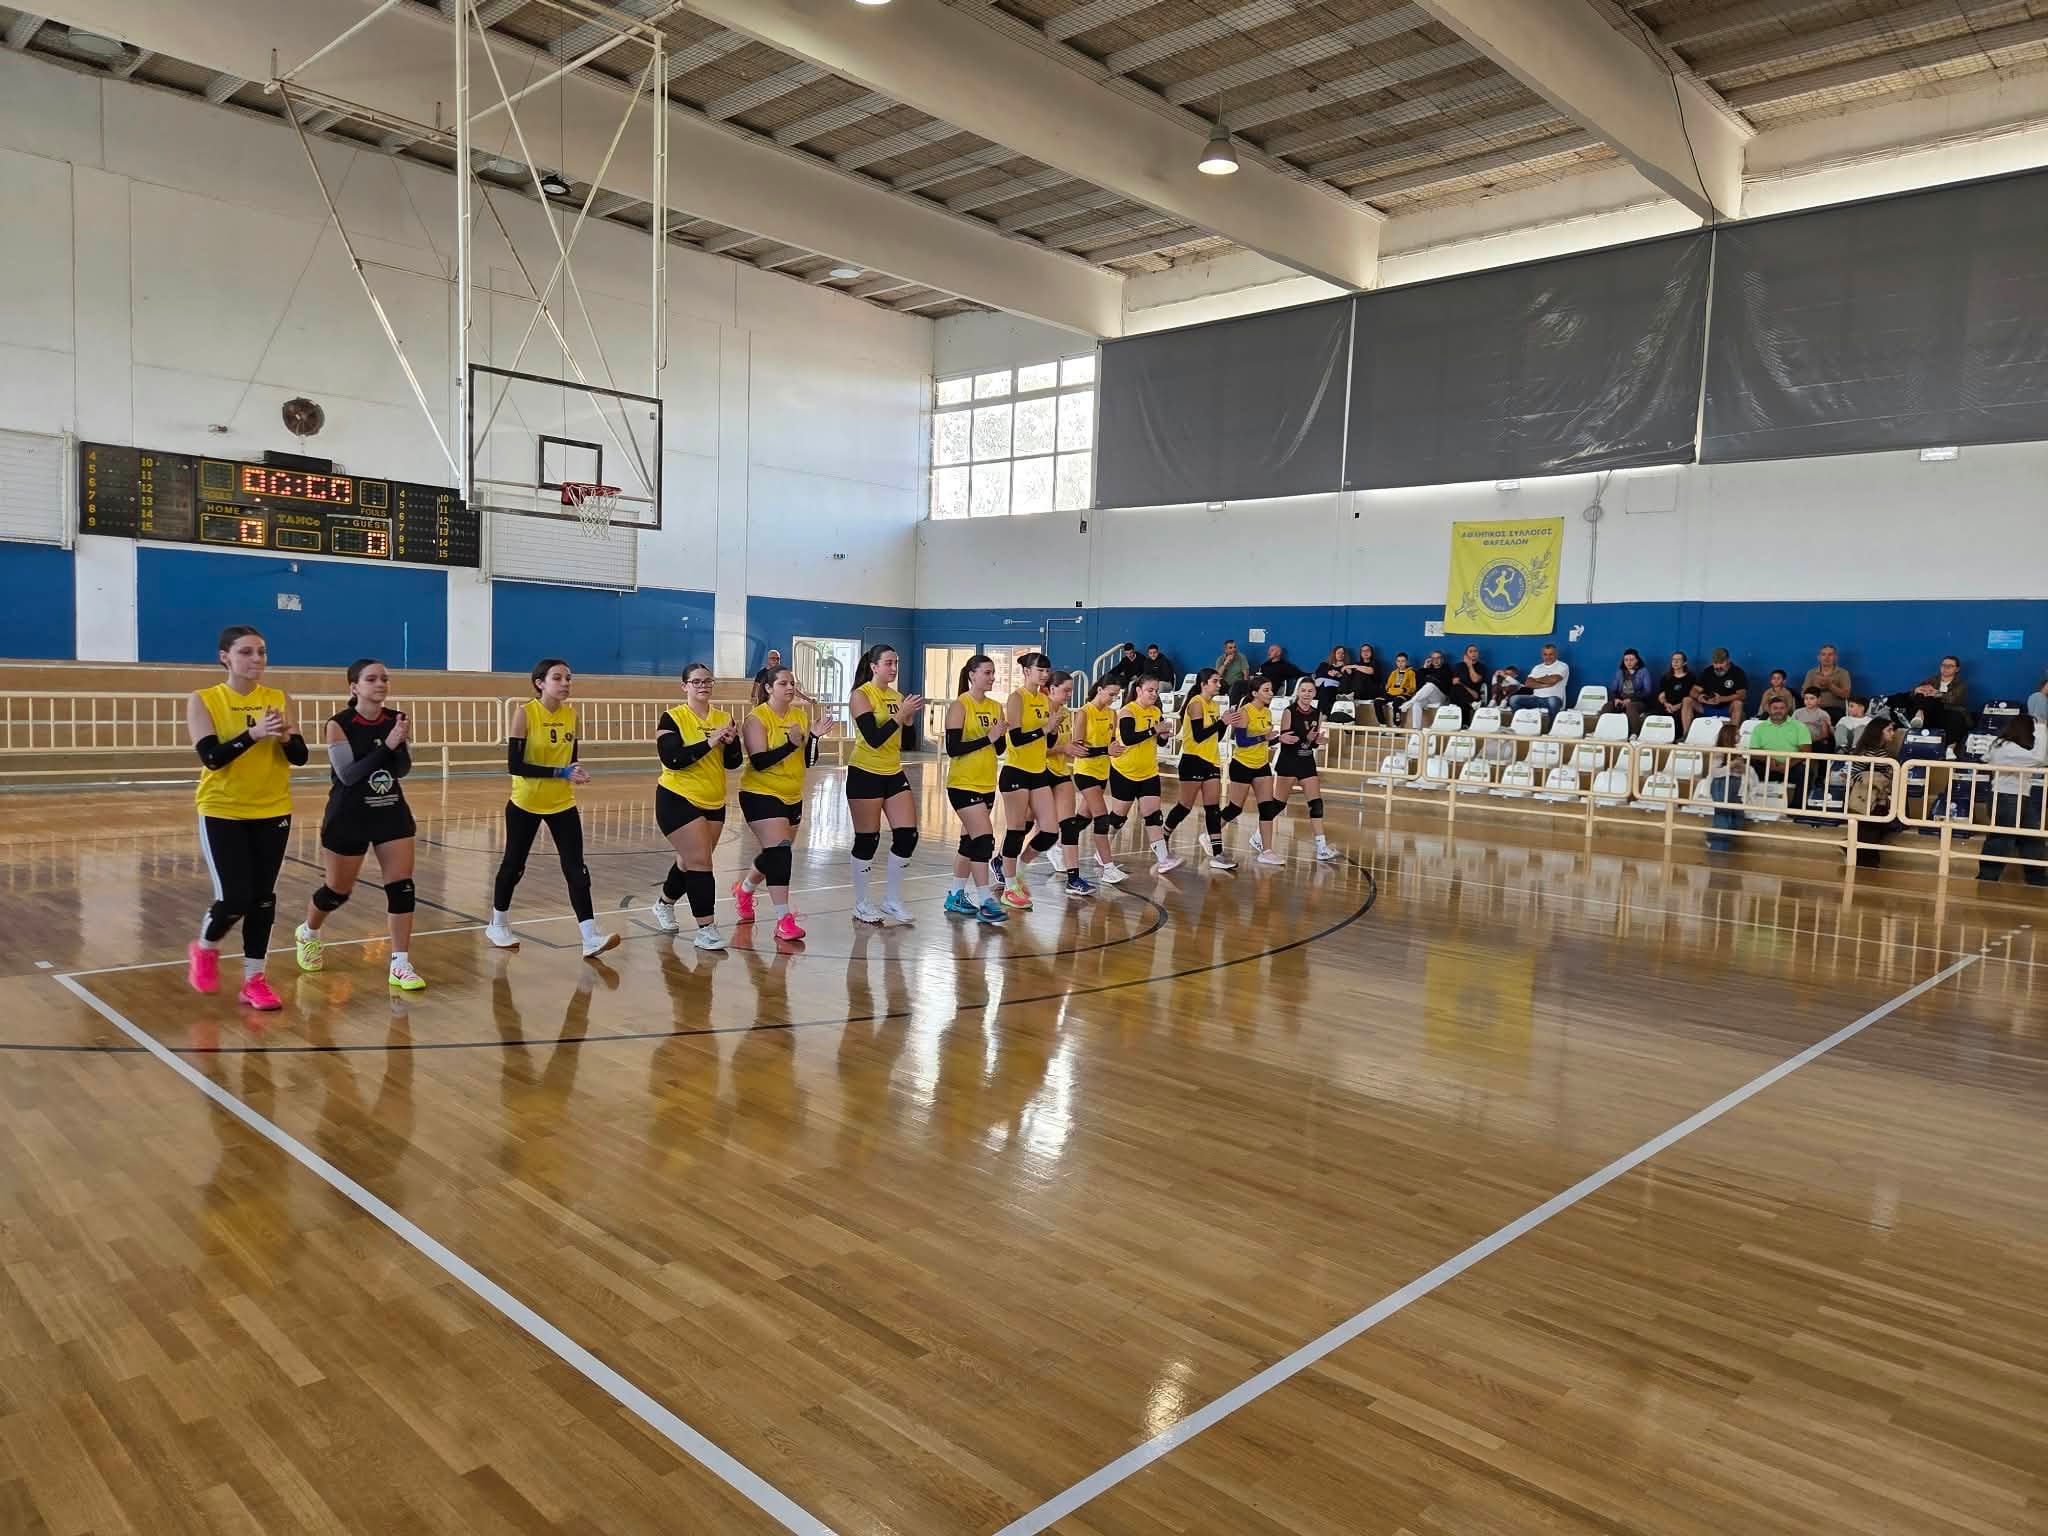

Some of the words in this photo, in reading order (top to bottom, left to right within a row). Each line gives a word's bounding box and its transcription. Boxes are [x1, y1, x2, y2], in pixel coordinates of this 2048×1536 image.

[88, 451, 97, 460] 4
[141, 457, 153, 468] 10
[88, 464, 97, 474] 5
[141, 470, 152, 480] 11
[88, 477, 97, 487] 6
[141, 483, 153, 493] 12
[88, 490, 97, 500] 7
[399, 490, 405, 498] 4
[439, 494, 449, 503] 10
[141, 496, 153, 506] 13
[399, 501, 405, 509] 5
[88, 503, 97, 513] 8
[208, 504, 241, 515] HOME
[439, 505, 448, 514] 11
[141, 509, 153, 519] 14
[399, 512, 405, 520] 6
[88, 517, 97, 527] 9
[352, 519, 388, 529] GUEST
[439, 516, 448, 525] 12
[141, 521, 153, 531] 15
[240, 519, 263, 544] 0
[439, 527, 448, 536] 13
[367, 532, 386, 554] 0
[439, 539, 448, 547] 14
[399, 546, 405, 554] 9
[439, 550, 448, 558] 15
[978, 715, 989, 727] 19
[550, 728, 558, 744] 9
